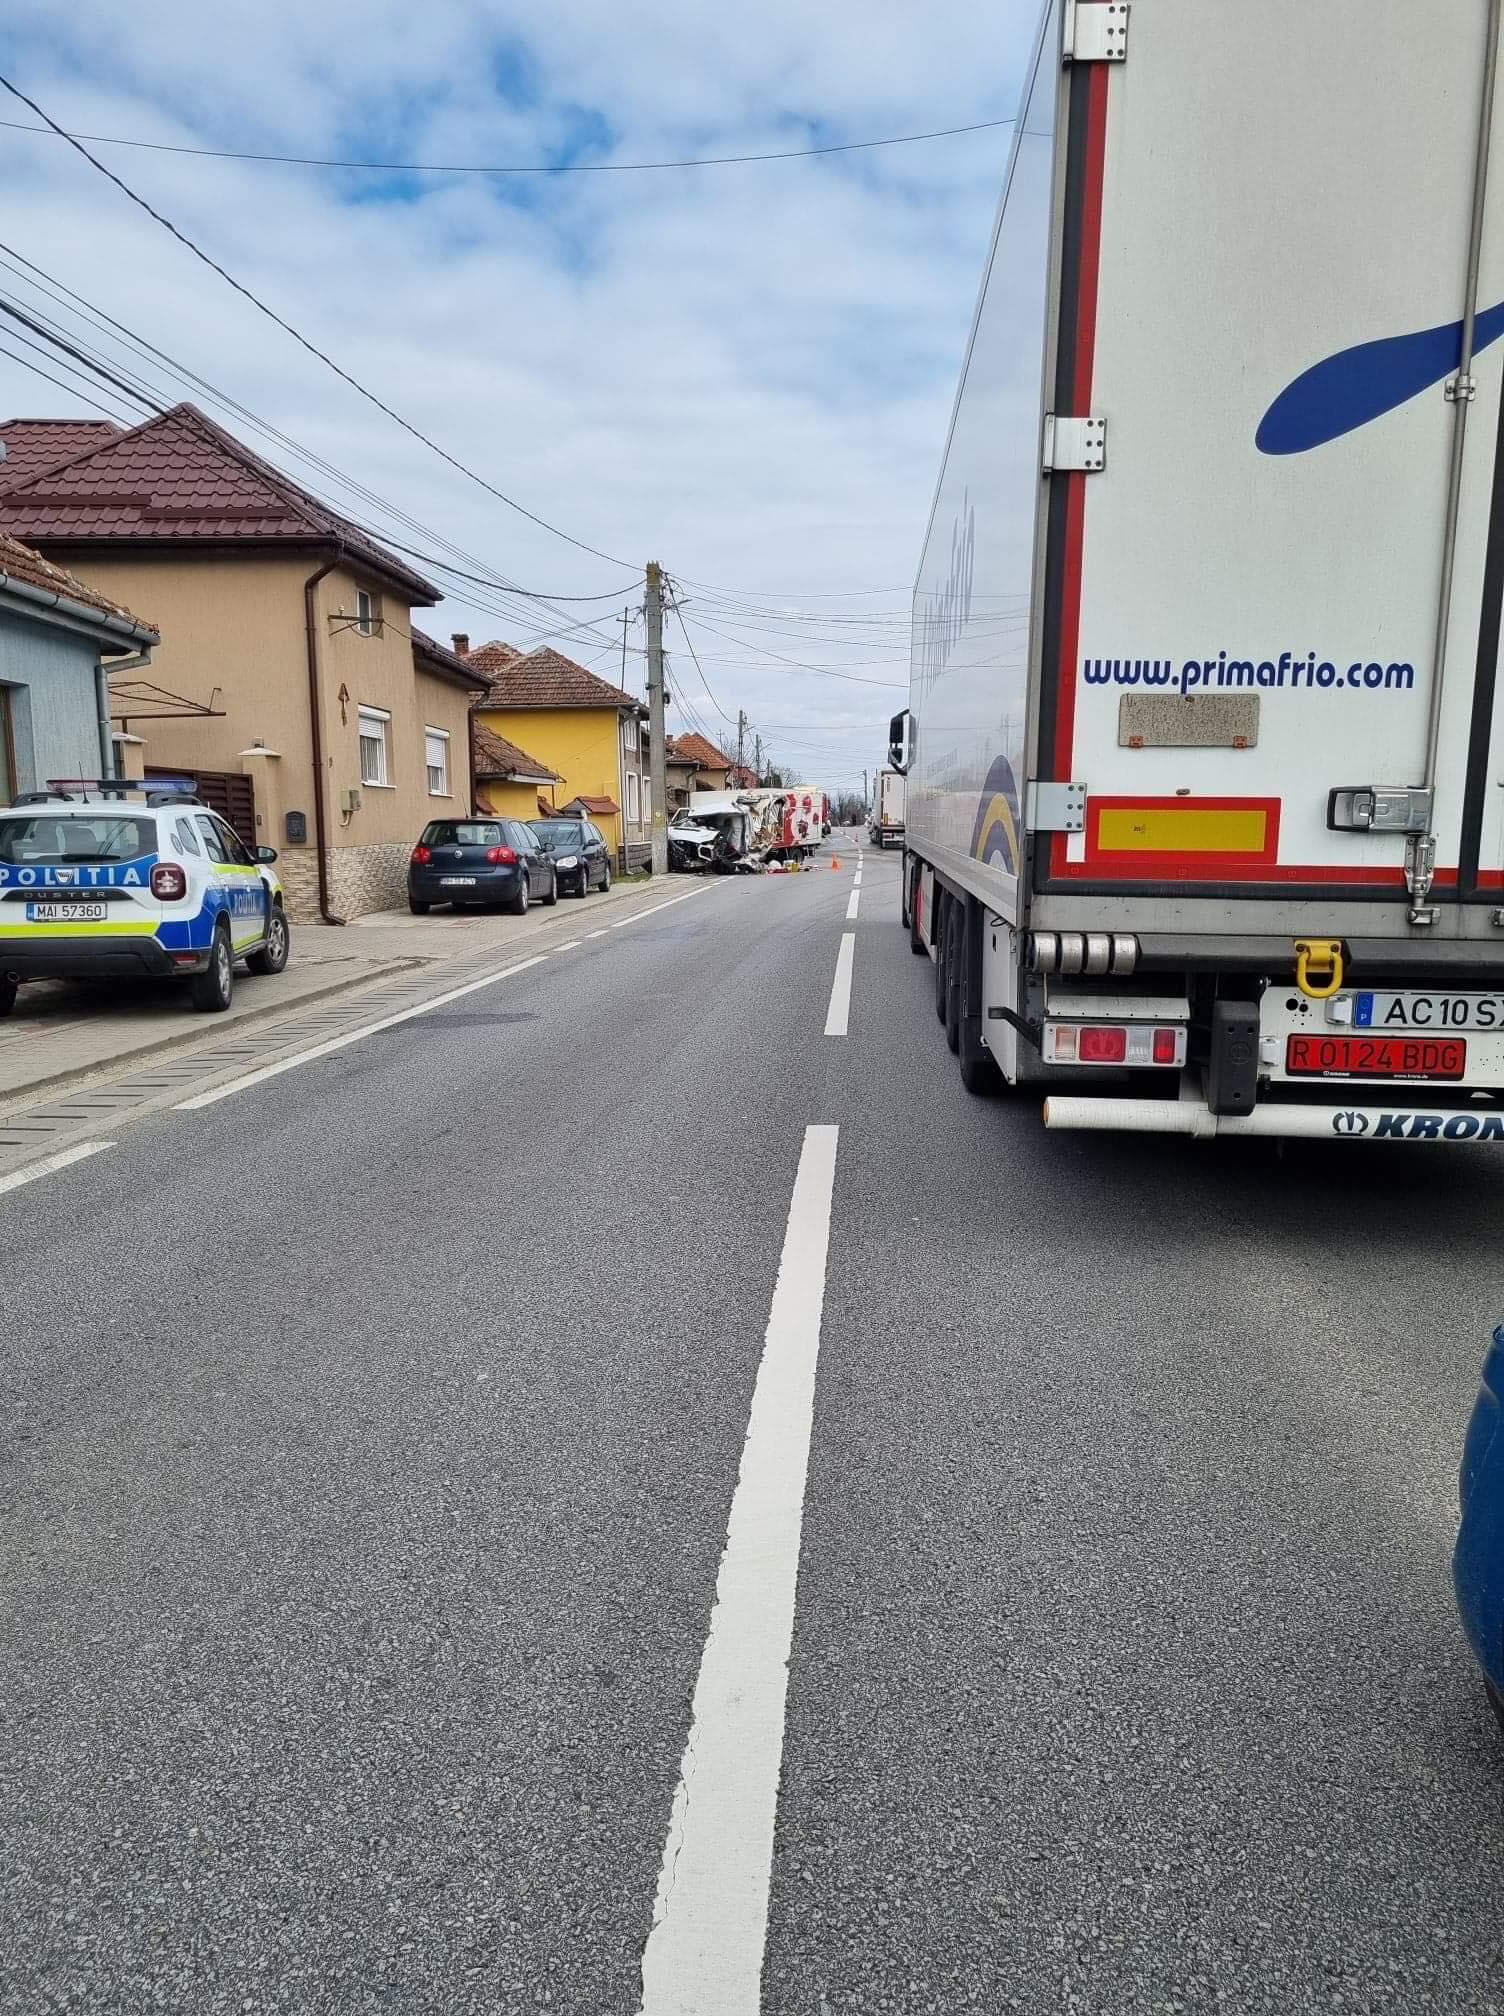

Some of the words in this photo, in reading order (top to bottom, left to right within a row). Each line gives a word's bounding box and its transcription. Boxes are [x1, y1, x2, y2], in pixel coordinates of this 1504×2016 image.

[1084, 651, 1414, 694] www.primafrio.com
[37, 905, 57, 917] MAI
[62, 905, 102, 917] 57360
[1361, 1013, 1367, 1021] P
[1384, 998, 1433, 1025] AC
[1440, 999, 1469, 1025] 10
[1293, 1041, 1310, 1066] R
[1320, 1041, 1393, 1069] 0124
[1403, 1044, 1457, 1070] BDG
